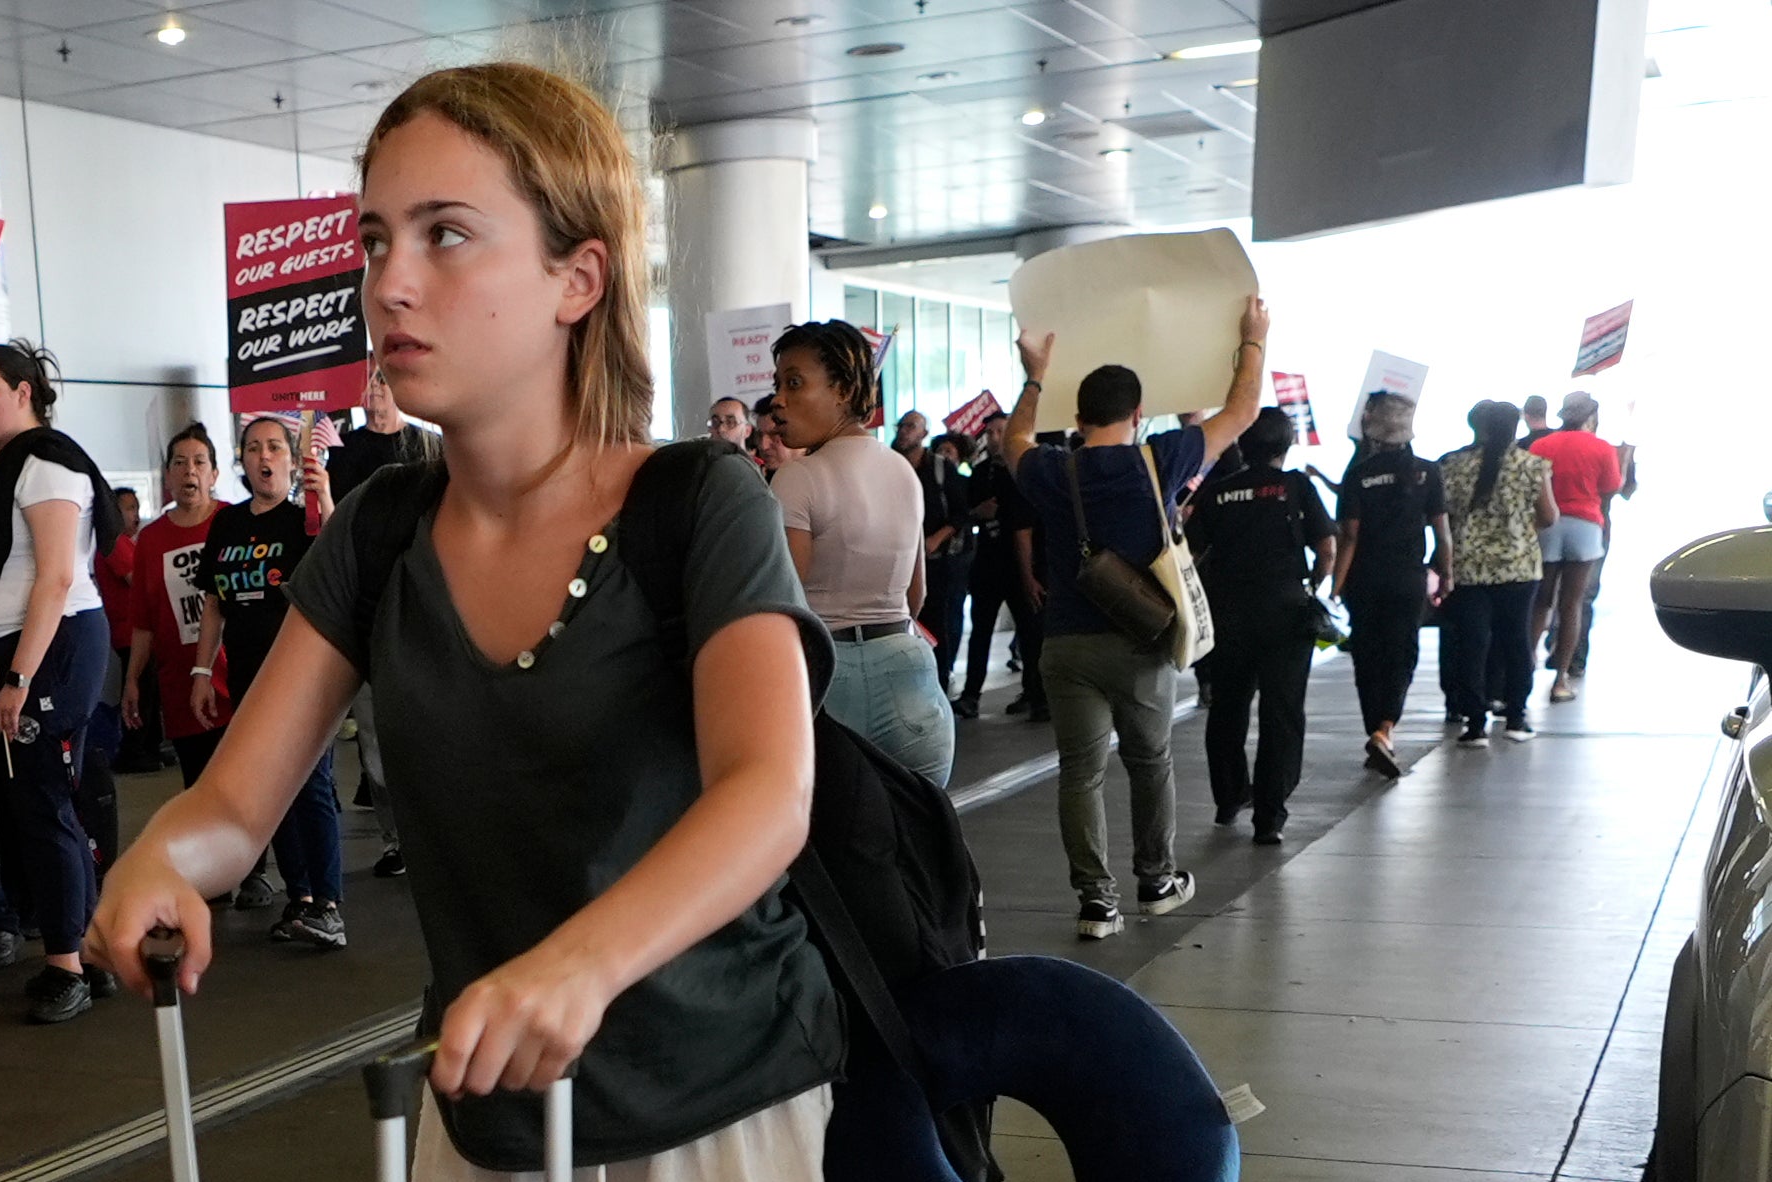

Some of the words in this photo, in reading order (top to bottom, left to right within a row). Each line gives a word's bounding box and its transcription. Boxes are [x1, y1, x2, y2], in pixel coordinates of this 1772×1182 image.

[235, 208, 353, 260] RESPECT
[234, 261, 276, 286] OUR
[279, 239, 355, 275] GUESTS
[237, 287, 356, 334] RESPECT
[237, 333, 283, 361] OUR
[287, 315, 357, 349] WORK
[172, 549, 202, 569] ON
[216, 535, 284, 562] union
[213, 559, 283, 601] pride
